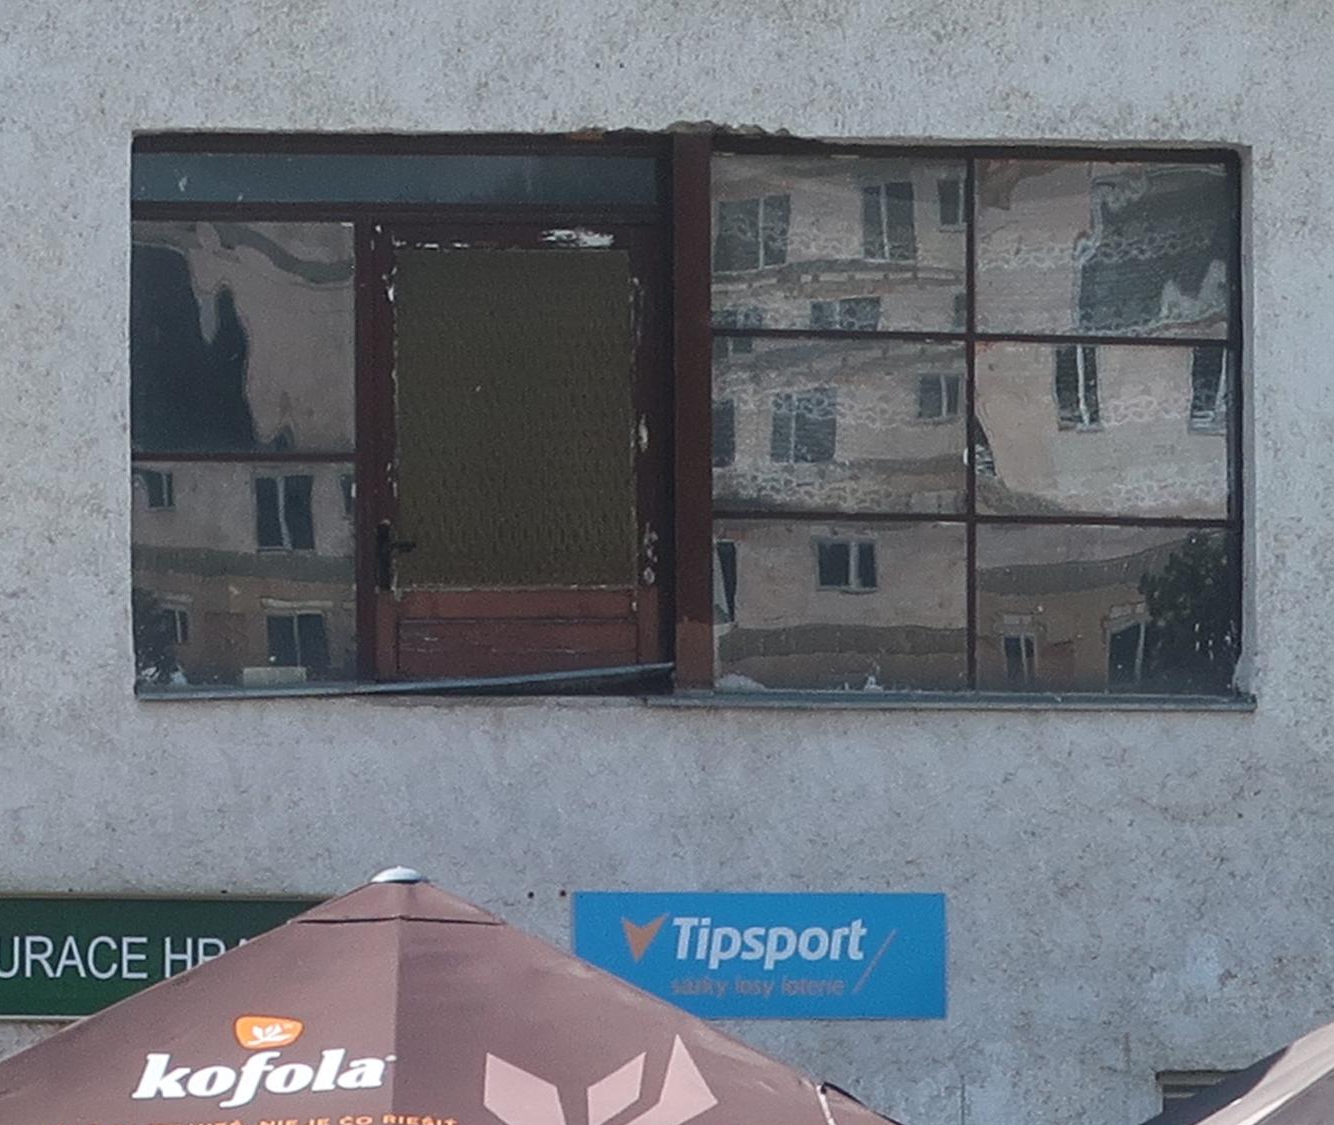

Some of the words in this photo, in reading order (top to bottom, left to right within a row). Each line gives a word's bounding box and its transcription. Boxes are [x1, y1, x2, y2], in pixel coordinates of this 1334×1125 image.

[164, 936, 247, 979] HR
[672, 916, 868, 970] Tipsport
[131, 1047, 385, 1109] kofola
